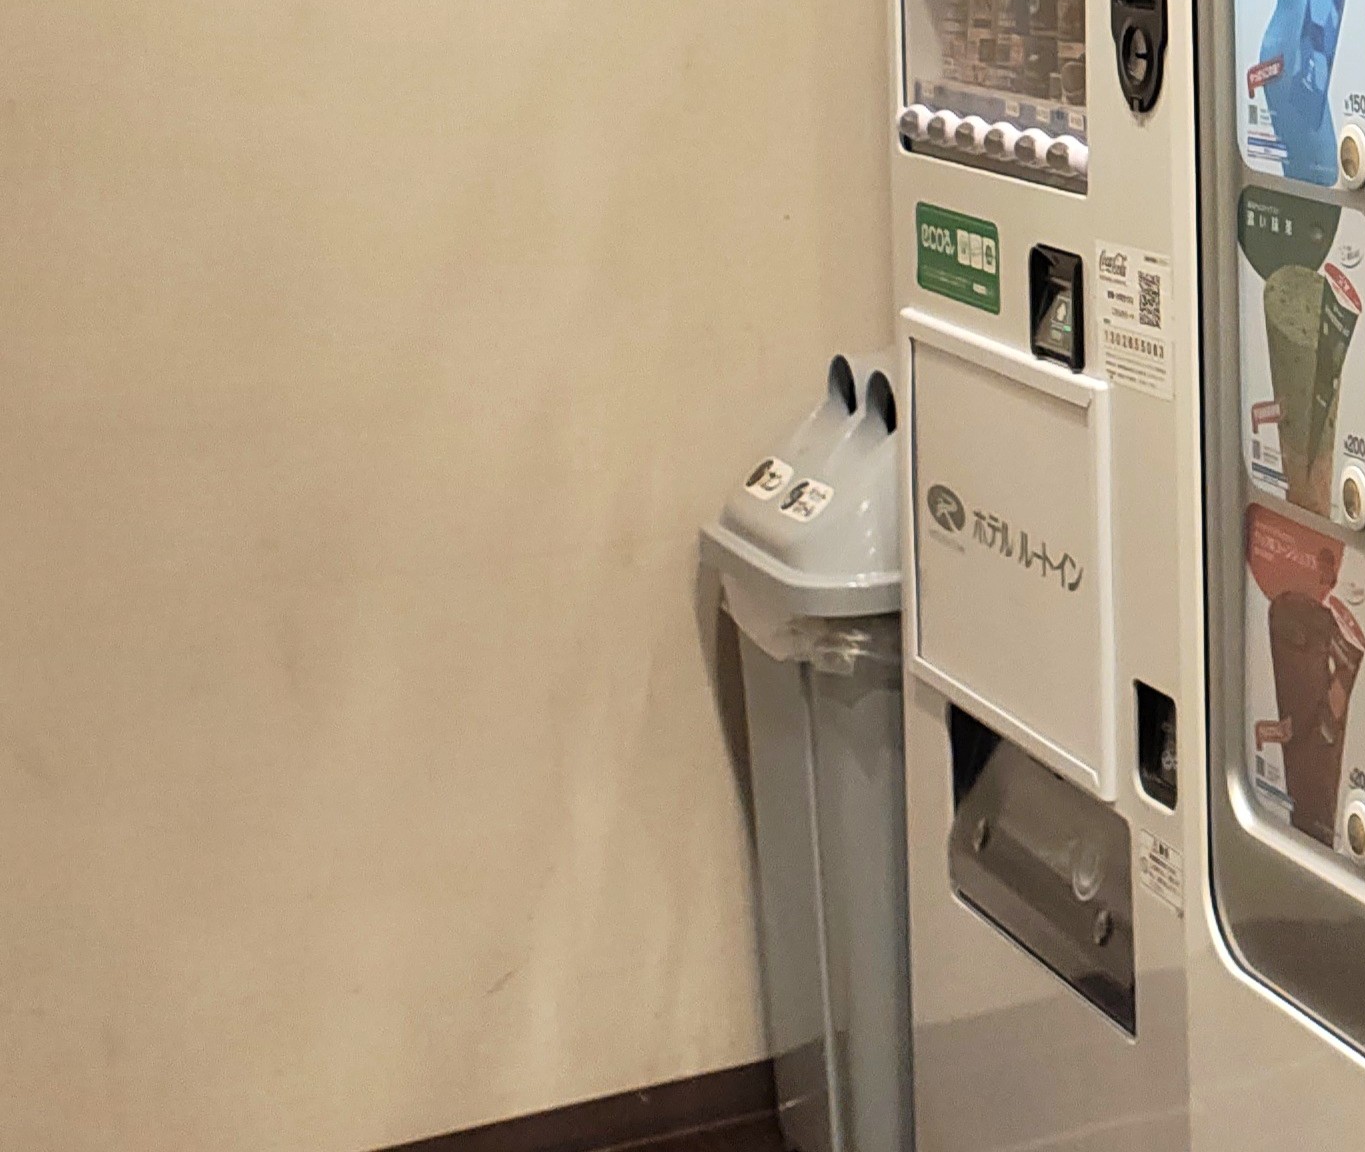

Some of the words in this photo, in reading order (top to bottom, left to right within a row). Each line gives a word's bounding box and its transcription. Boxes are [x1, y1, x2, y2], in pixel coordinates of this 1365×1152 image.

[973, 510, 1013, 557] ホテル
[1019, 531, 1083, 591] ルートイン
